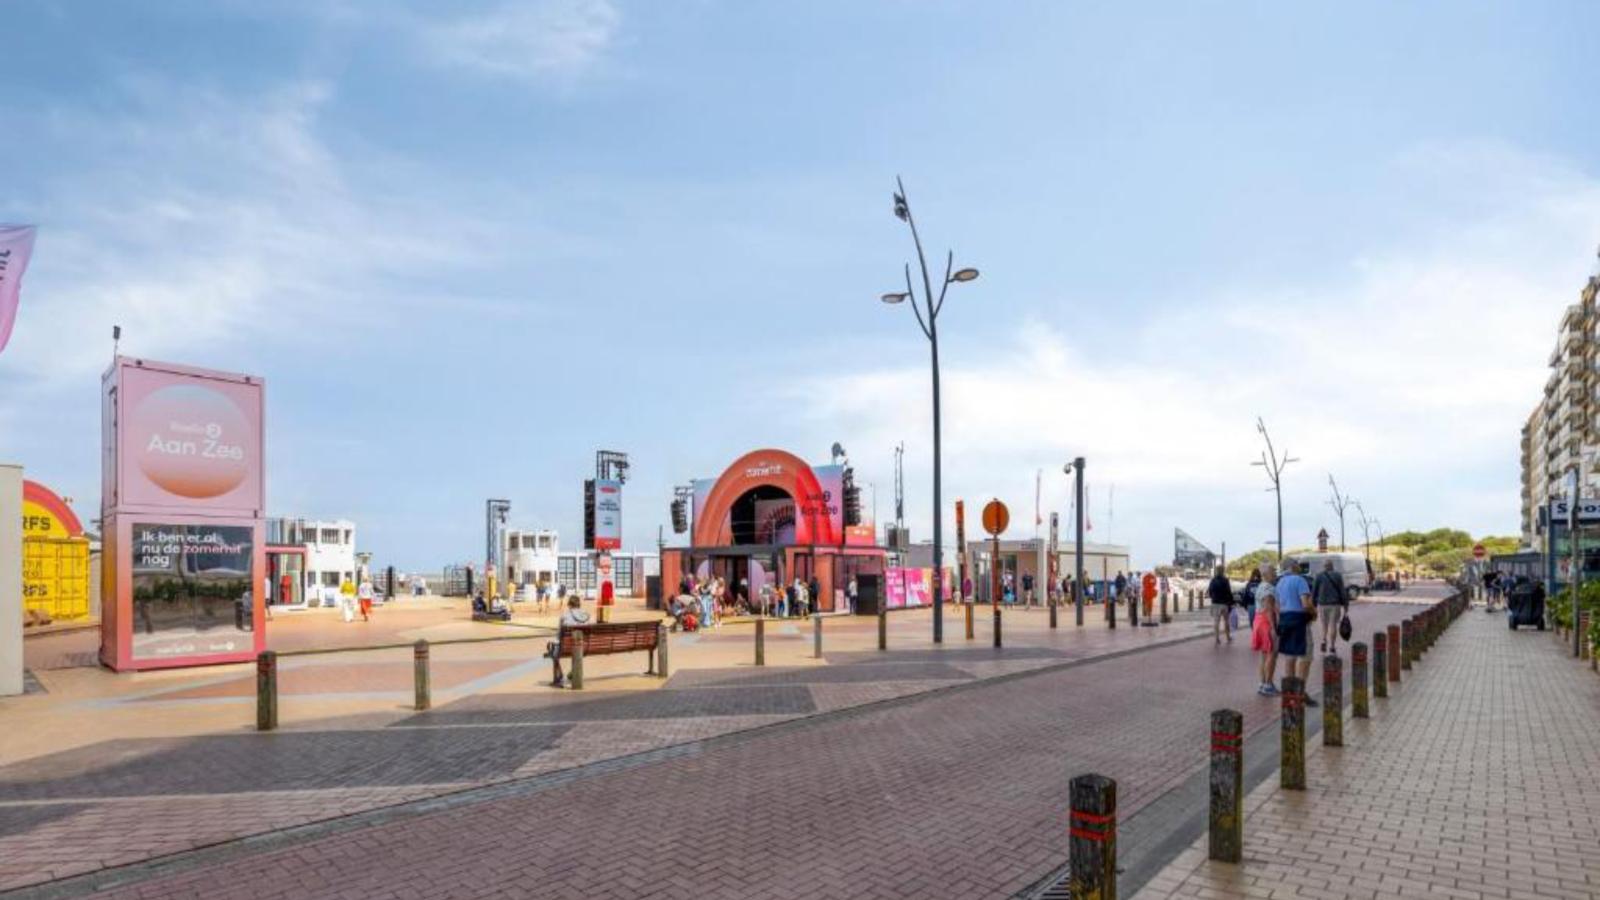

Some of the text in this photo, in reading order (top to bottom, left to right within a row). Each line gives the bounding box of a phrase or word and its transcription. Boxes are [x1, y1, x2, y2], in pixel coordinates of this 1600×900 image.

[146, 433, 244, 460] Aan Zee
[142, 530, 217, 543] Ik ben er al
[142, 543, 241, 555] nu de zomerhit
[142, 554, 170, 568] nog
